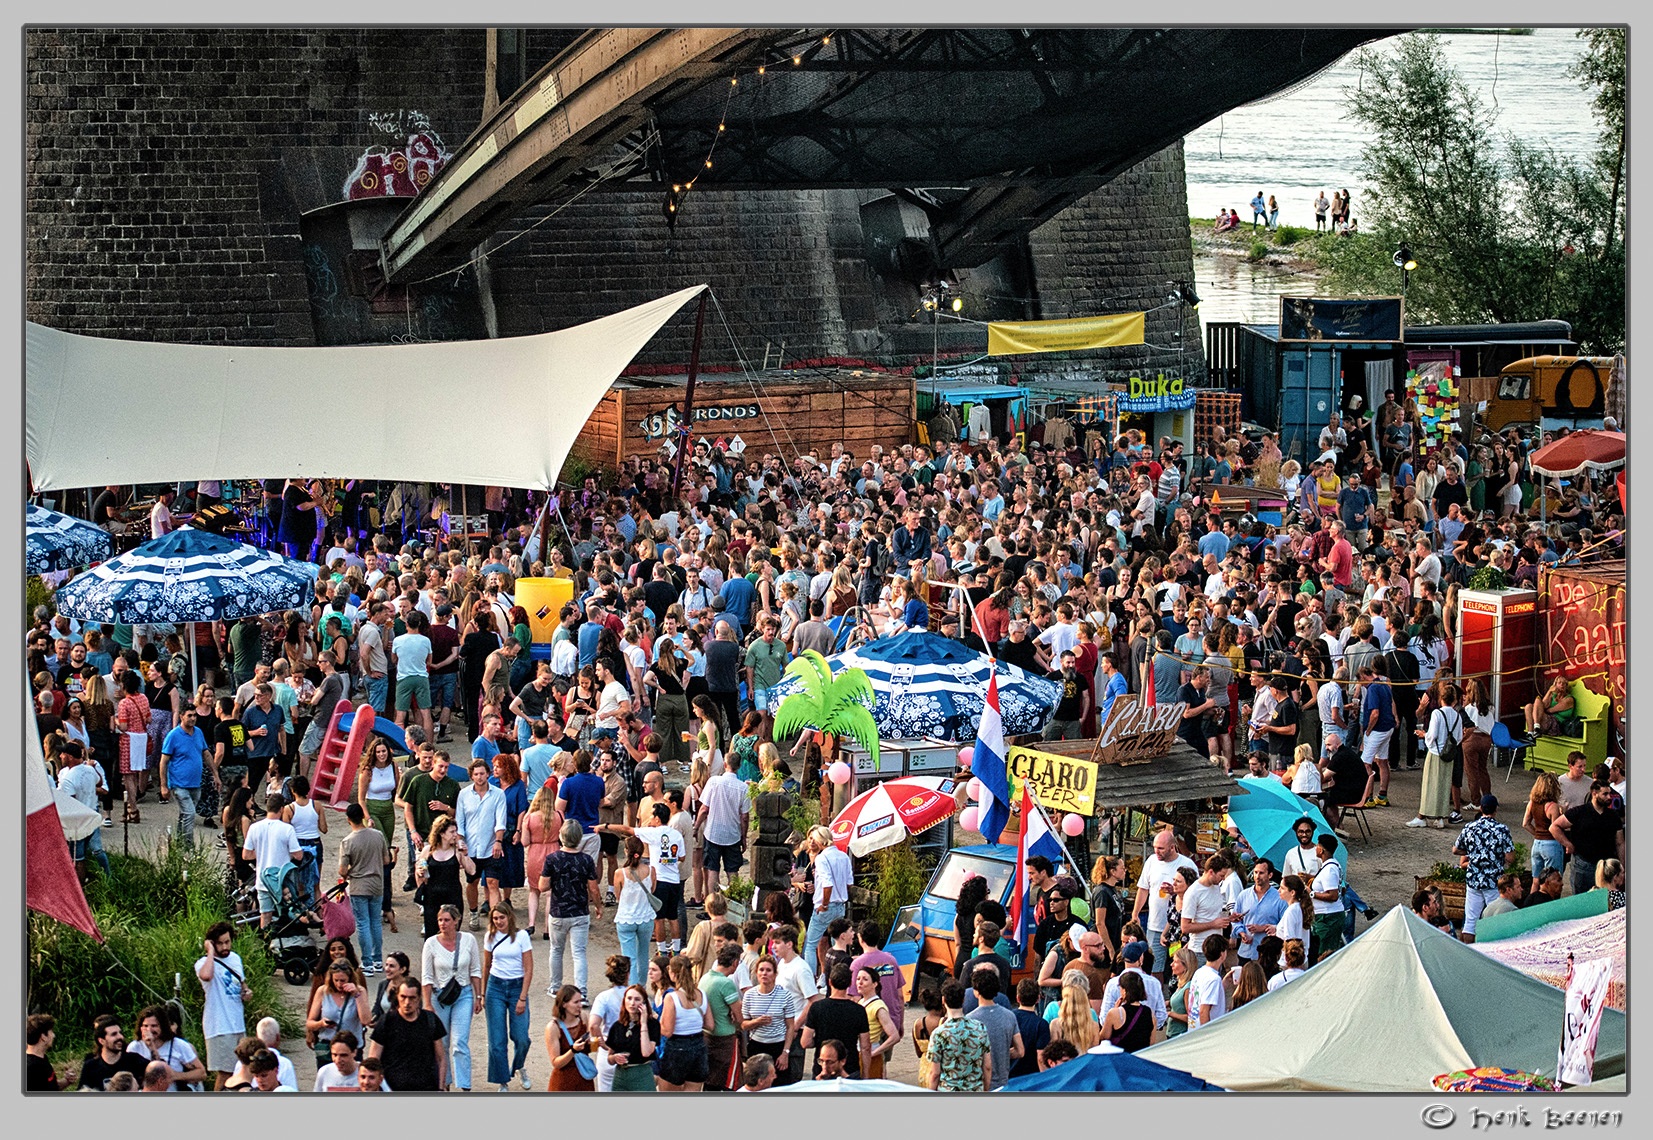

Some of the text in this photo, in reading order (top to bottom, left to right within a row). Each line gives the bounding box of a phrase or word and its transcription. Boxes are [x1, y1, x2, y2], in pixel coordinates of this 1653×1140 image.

[1129, 374, 1183, 399] Duka
[1464, 601, 1496, 613] TELEPHONE
[1555, 583, 1585, 607] De
[1505, 602, 1535, 614] TELEPHONE
[1101, 700, 1186, 748] CLARO
[1010, 753, 1089, 792] CLARO
[1027, 781, 1080, 809] BEER
[860, 817, 891, 834] SNICKERS
